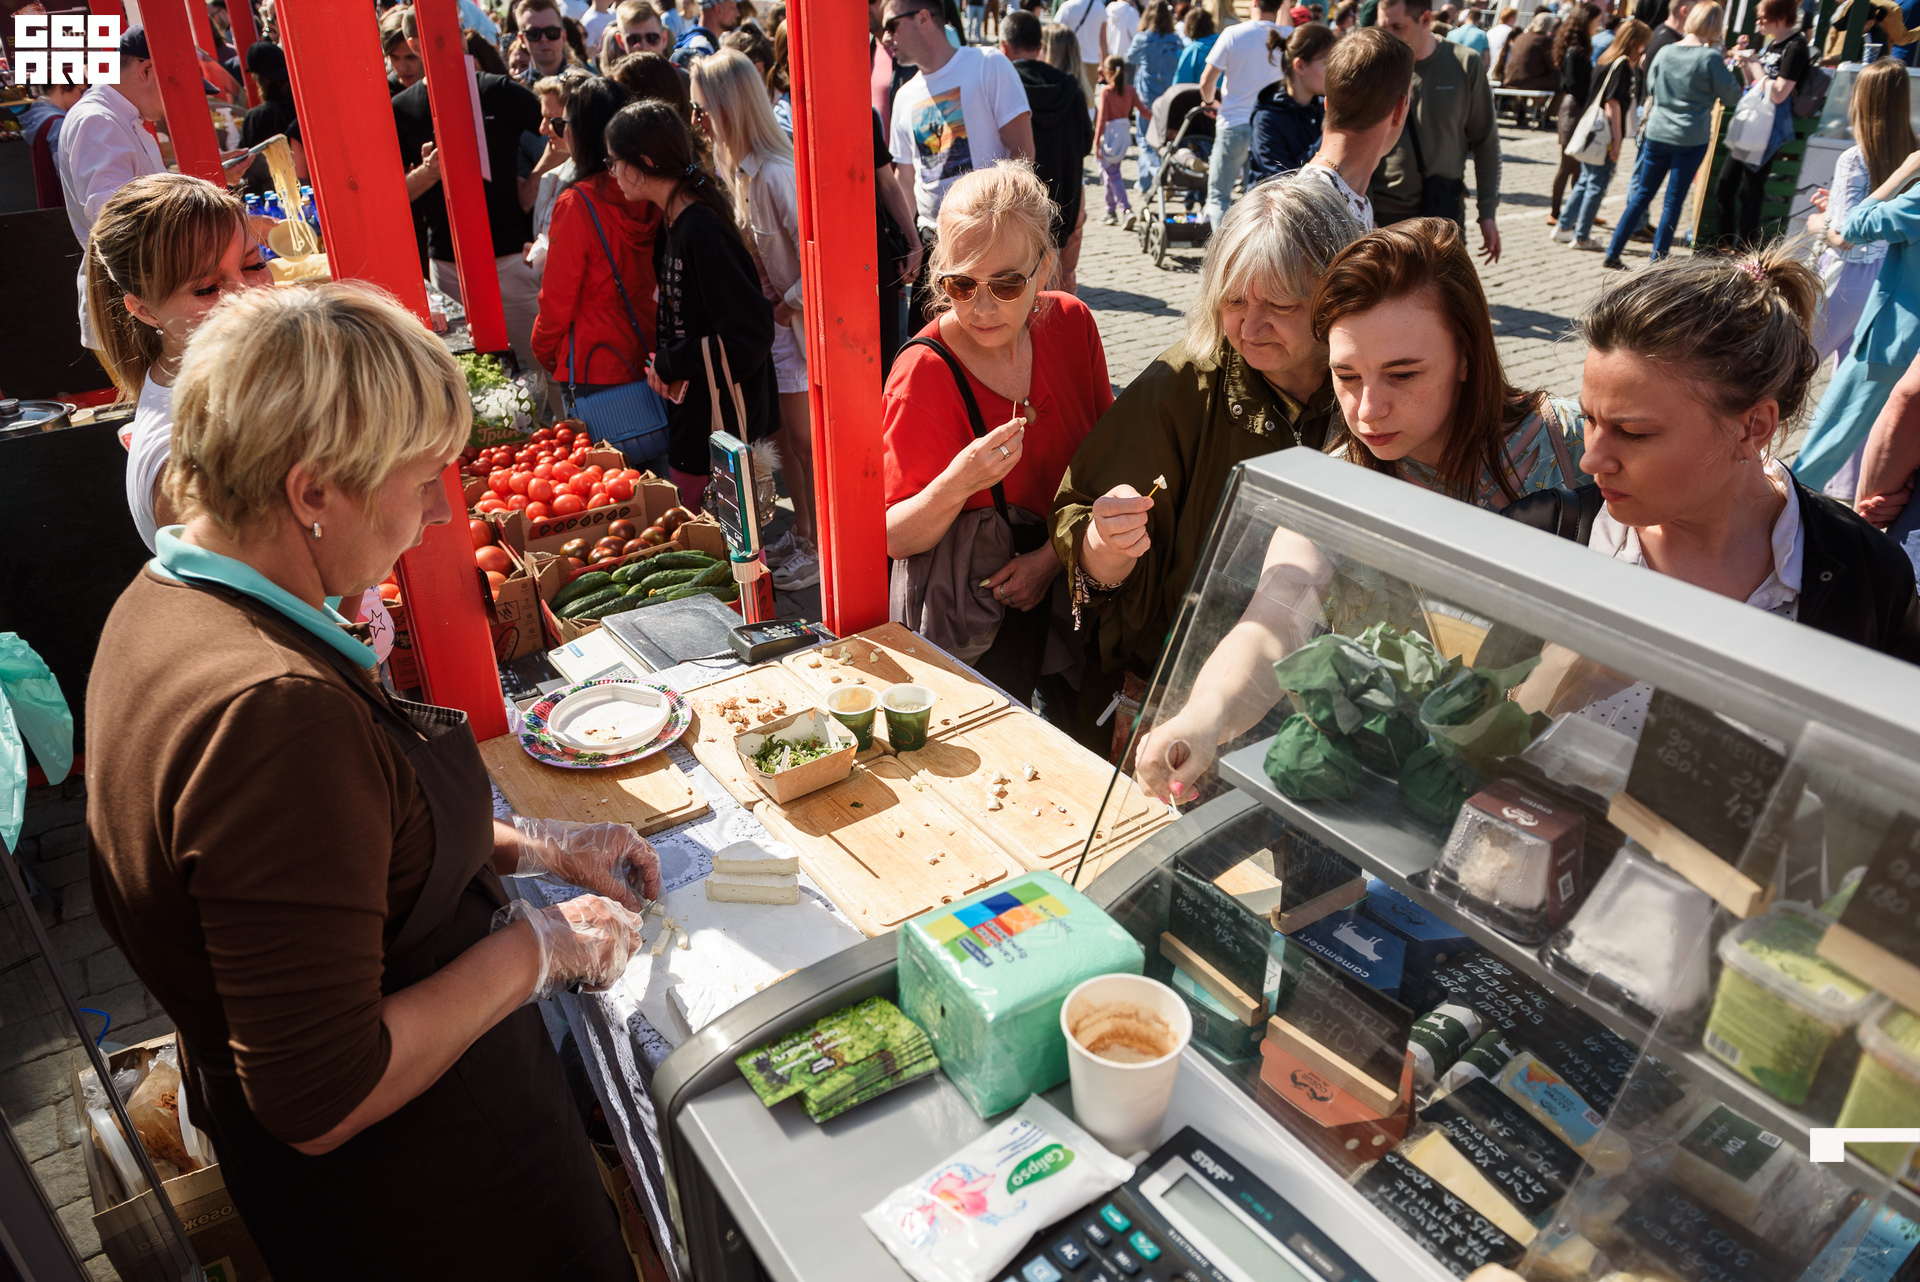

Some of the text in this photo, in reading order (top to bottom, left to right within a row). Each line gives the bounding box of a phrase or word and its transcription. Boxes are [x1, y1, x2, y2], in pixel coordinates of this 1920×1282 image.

[1297, 931, 1370, 979] camembert
[1462, 960, 1544, 1024] БЮШ ПЕПЕЛ
[1474, 983, 1516, 1017] КОЗА
[1474, 997, 1516, 1030] БЮШ
[1299, 1072, 1328, 1094] COEUR
[1454, 1113, 1509, 1162] ЖАРКИ
[1007, 1144, 1066, 1188] Calipso
[1189, 1147, 1231, 1183] STAFF
[1375, 1181, 1486, 1269] ЫР КАЧОТТА
[1060, 1242, 1079, 1261] AC
